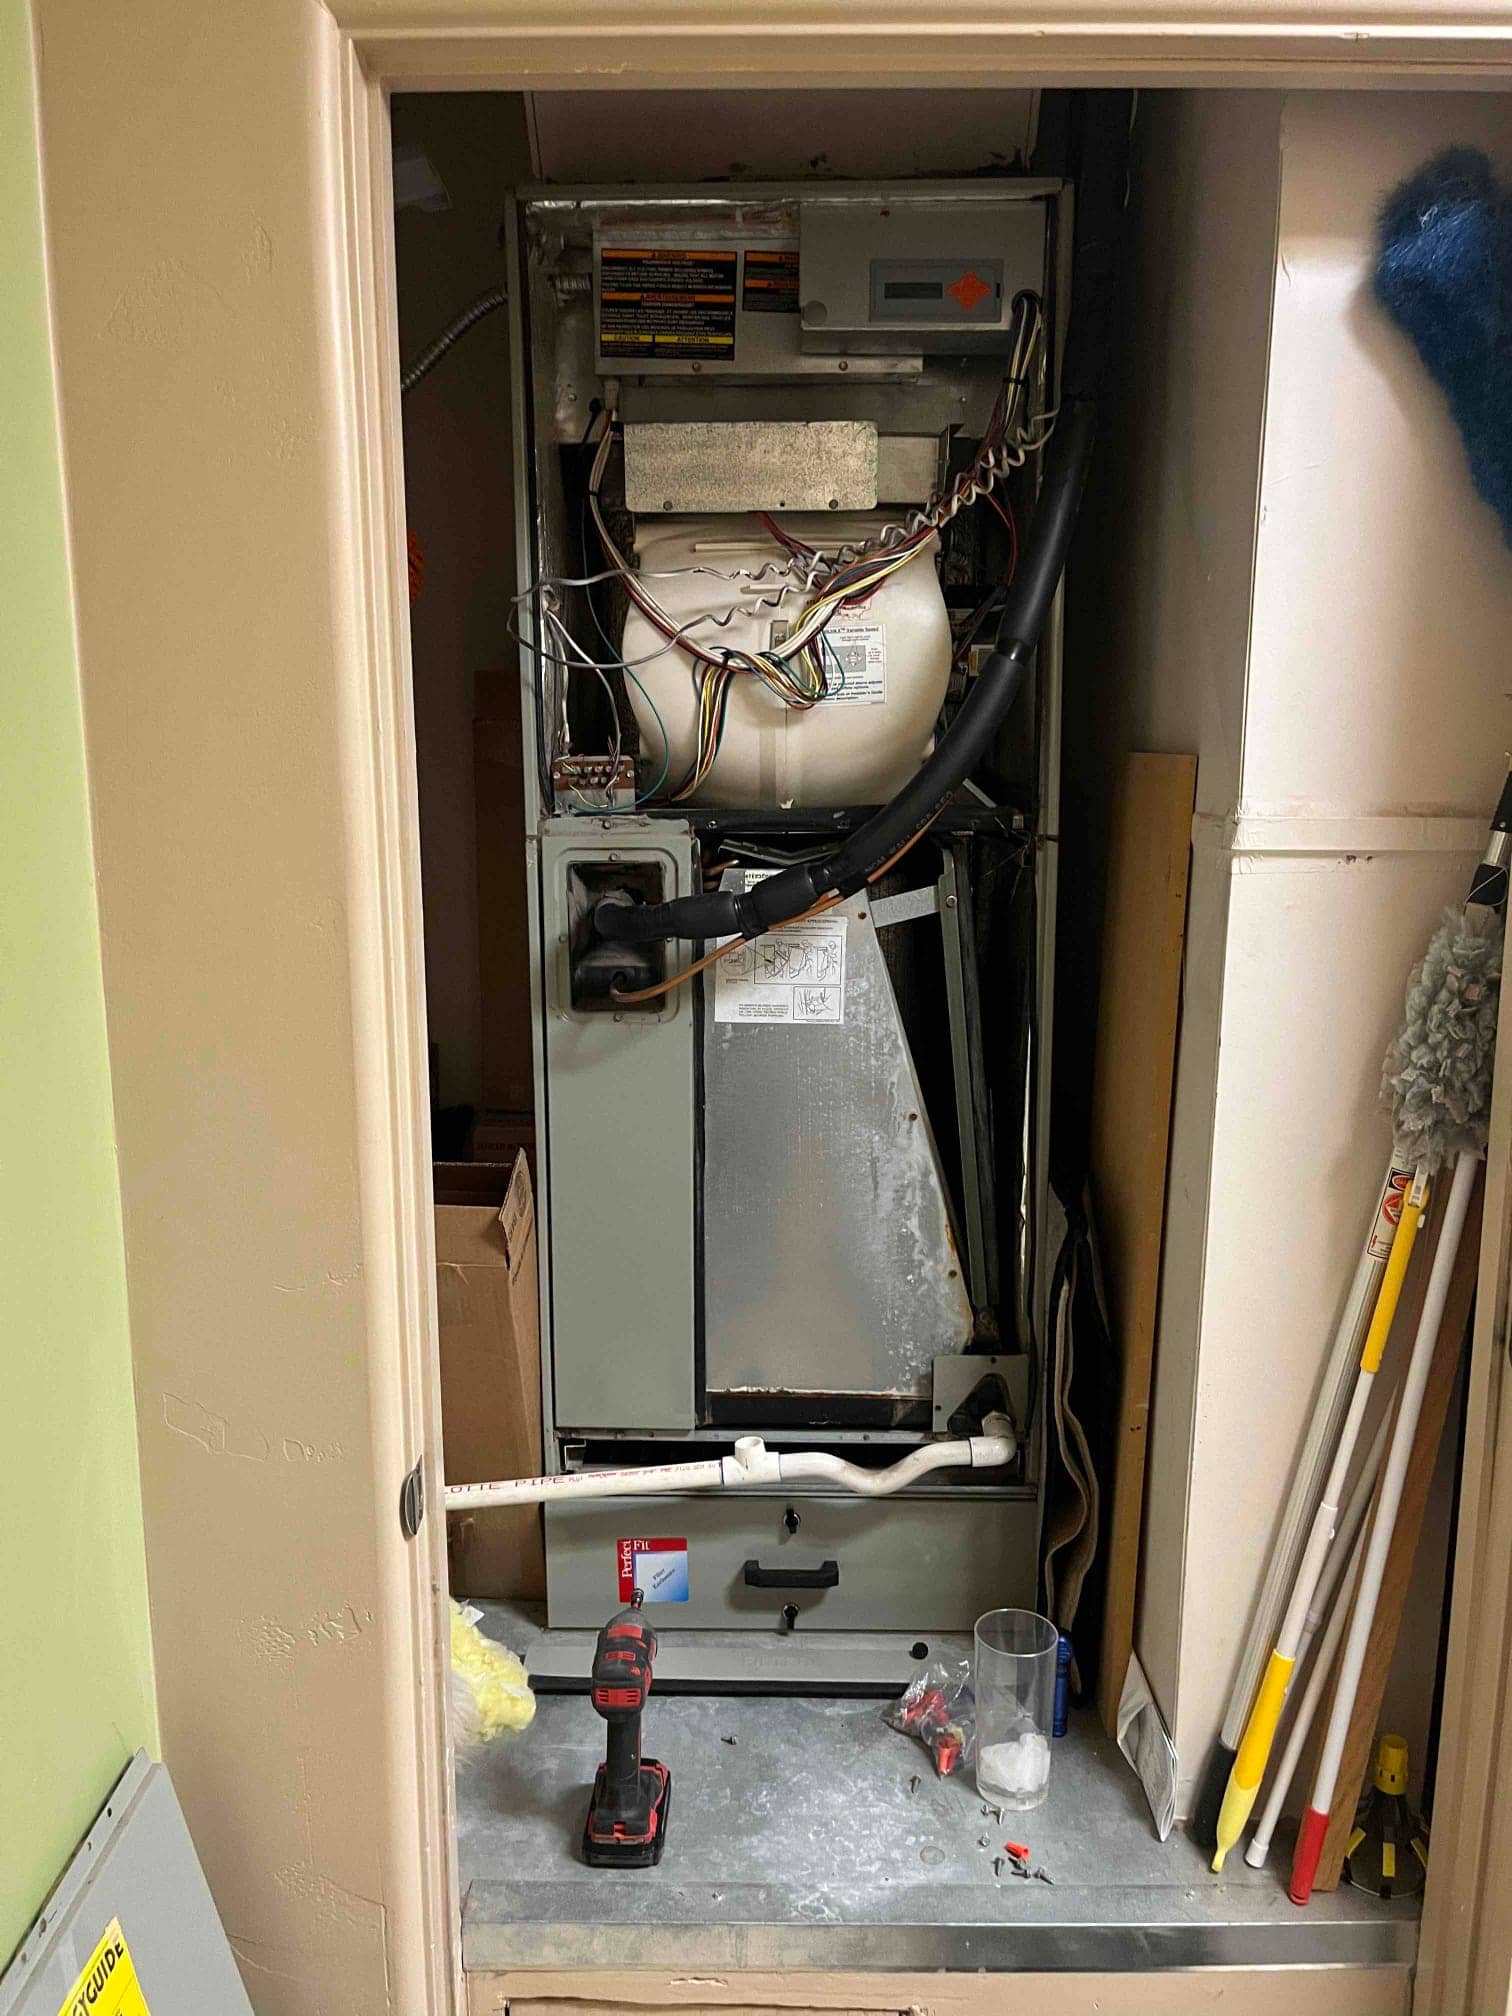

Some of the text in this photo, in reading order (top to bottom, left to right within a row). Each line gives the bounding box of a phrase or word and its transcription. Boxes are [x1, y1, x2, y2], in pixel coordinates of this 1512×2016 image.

[514, 1477, 565, 1488] PIPE
[633, 1540, 650, 1551] Fit
[620, 1540, 633, 1578] Perfect
